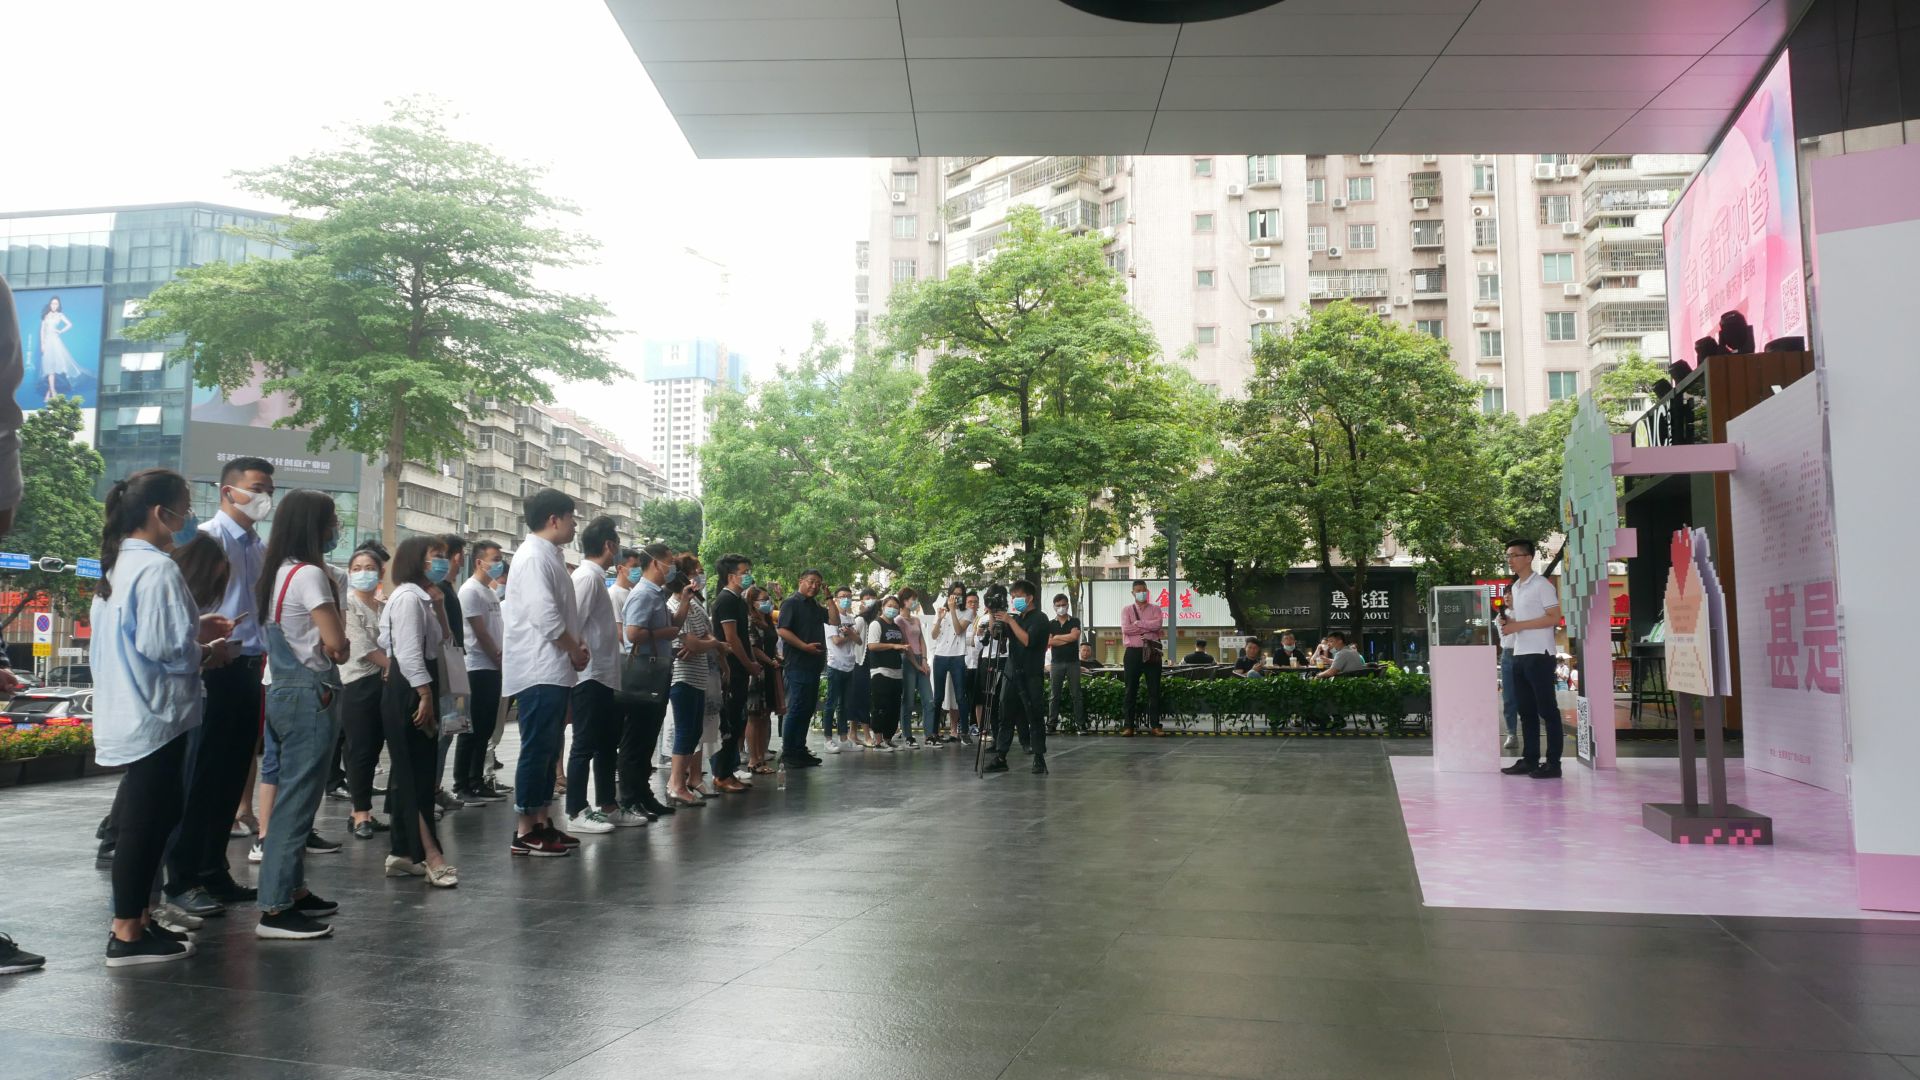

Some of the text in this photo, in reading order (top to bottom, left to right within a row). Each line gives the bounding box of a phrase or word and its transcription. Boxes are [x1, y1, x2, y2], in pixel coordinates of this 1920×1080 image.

[217, 452, 330, 470] 文化创意产业园
[1764, 580, 1842, 695] 甚是
